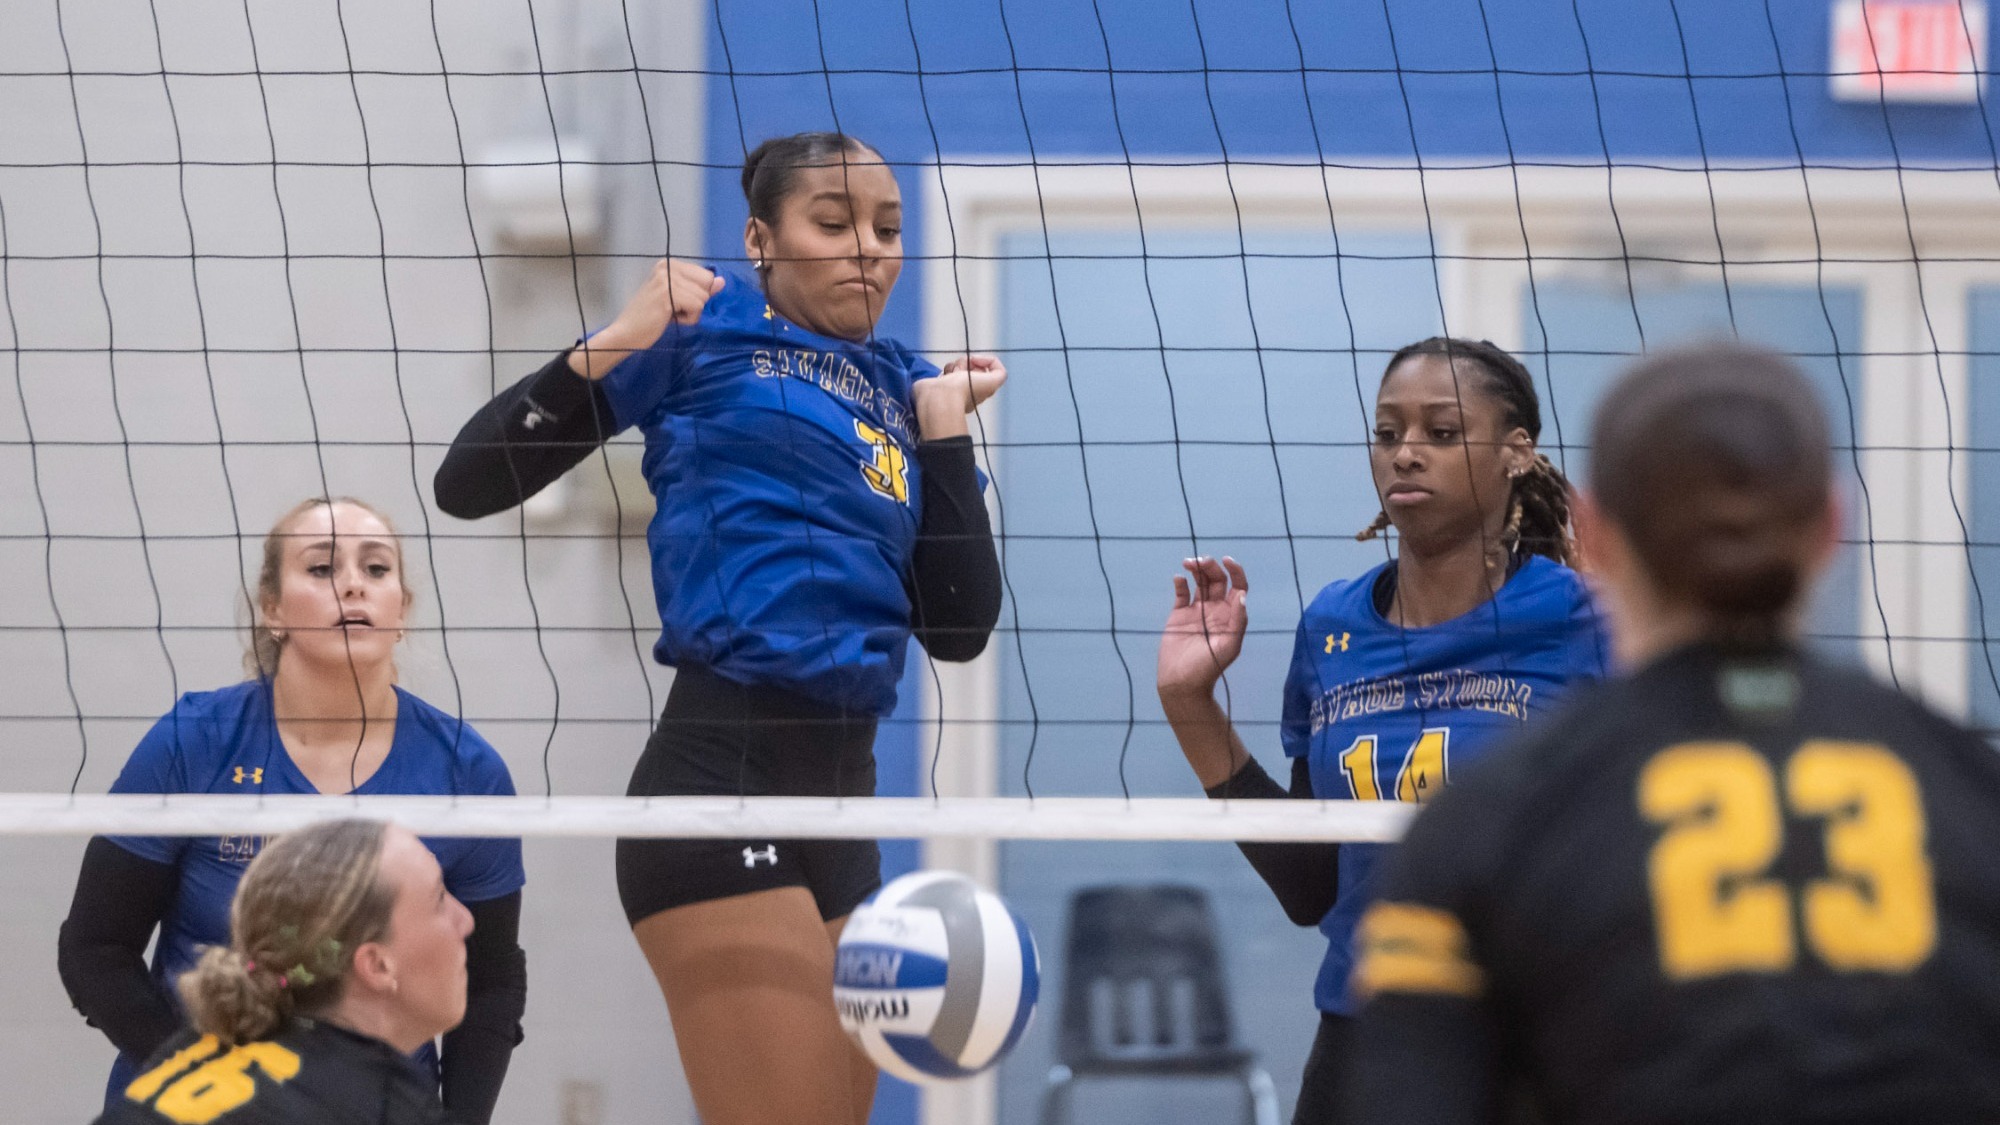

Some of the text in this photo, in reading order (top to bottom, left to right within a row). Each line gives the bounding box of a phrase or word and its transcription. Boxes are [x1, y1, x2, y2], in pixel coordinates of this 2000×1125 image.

[853, 418, 909, 507] 3
[1338, 726, 1450, 801] 14
[1637, 740, 1936, 980] 23
[124, 1033, 300, 1124] 16
